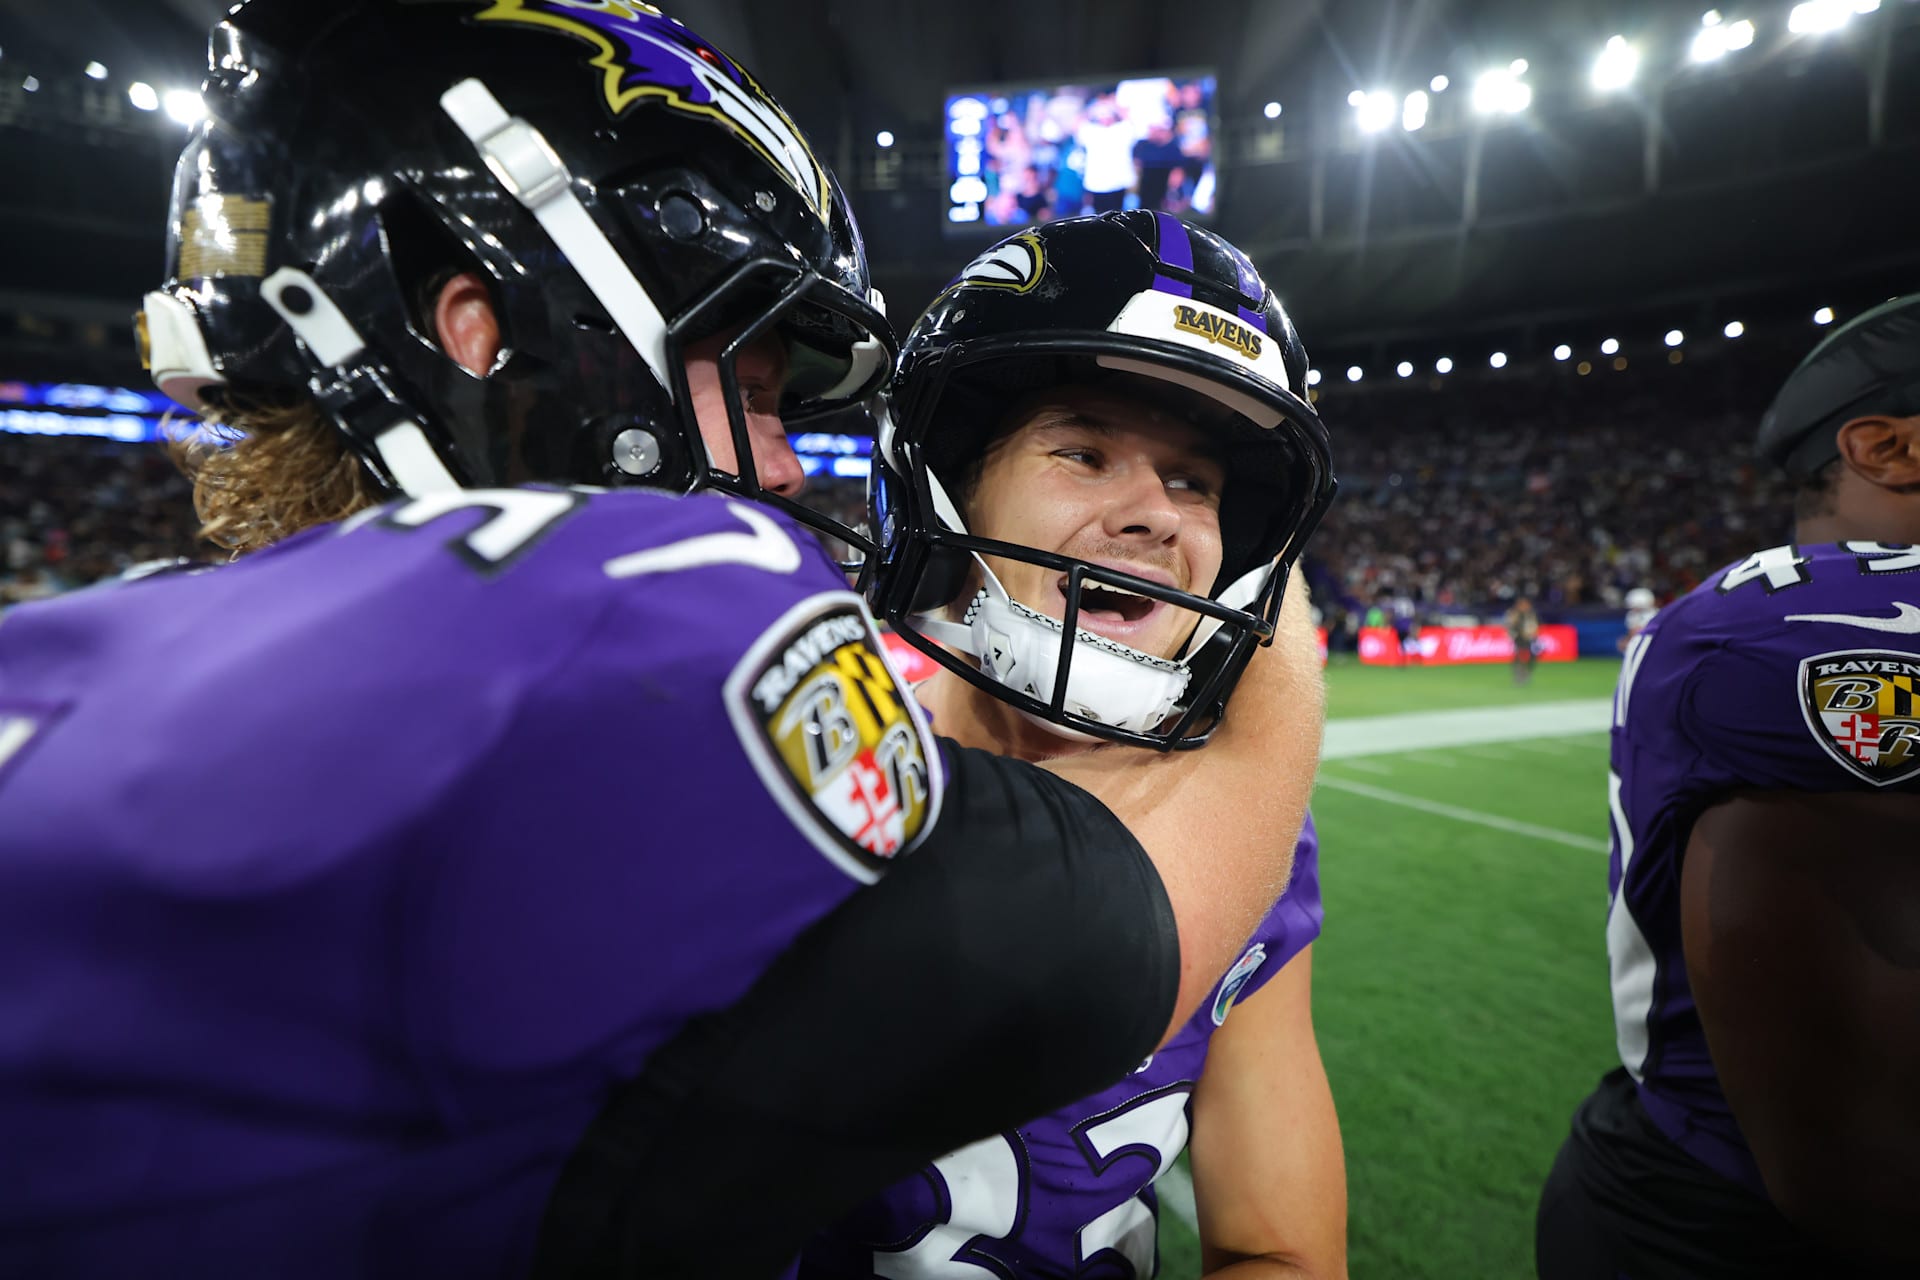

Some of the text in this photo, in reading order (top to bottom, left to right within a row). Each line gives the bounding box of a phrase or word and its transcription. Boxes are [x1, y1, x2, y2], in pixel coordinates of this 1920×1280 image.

[1174, 304, 1262, 360] RAVENS
[752, 615, 866, 713] RAVENS
[1817, 677, 1884, 711] B
[777, 673, 859, 794] B
